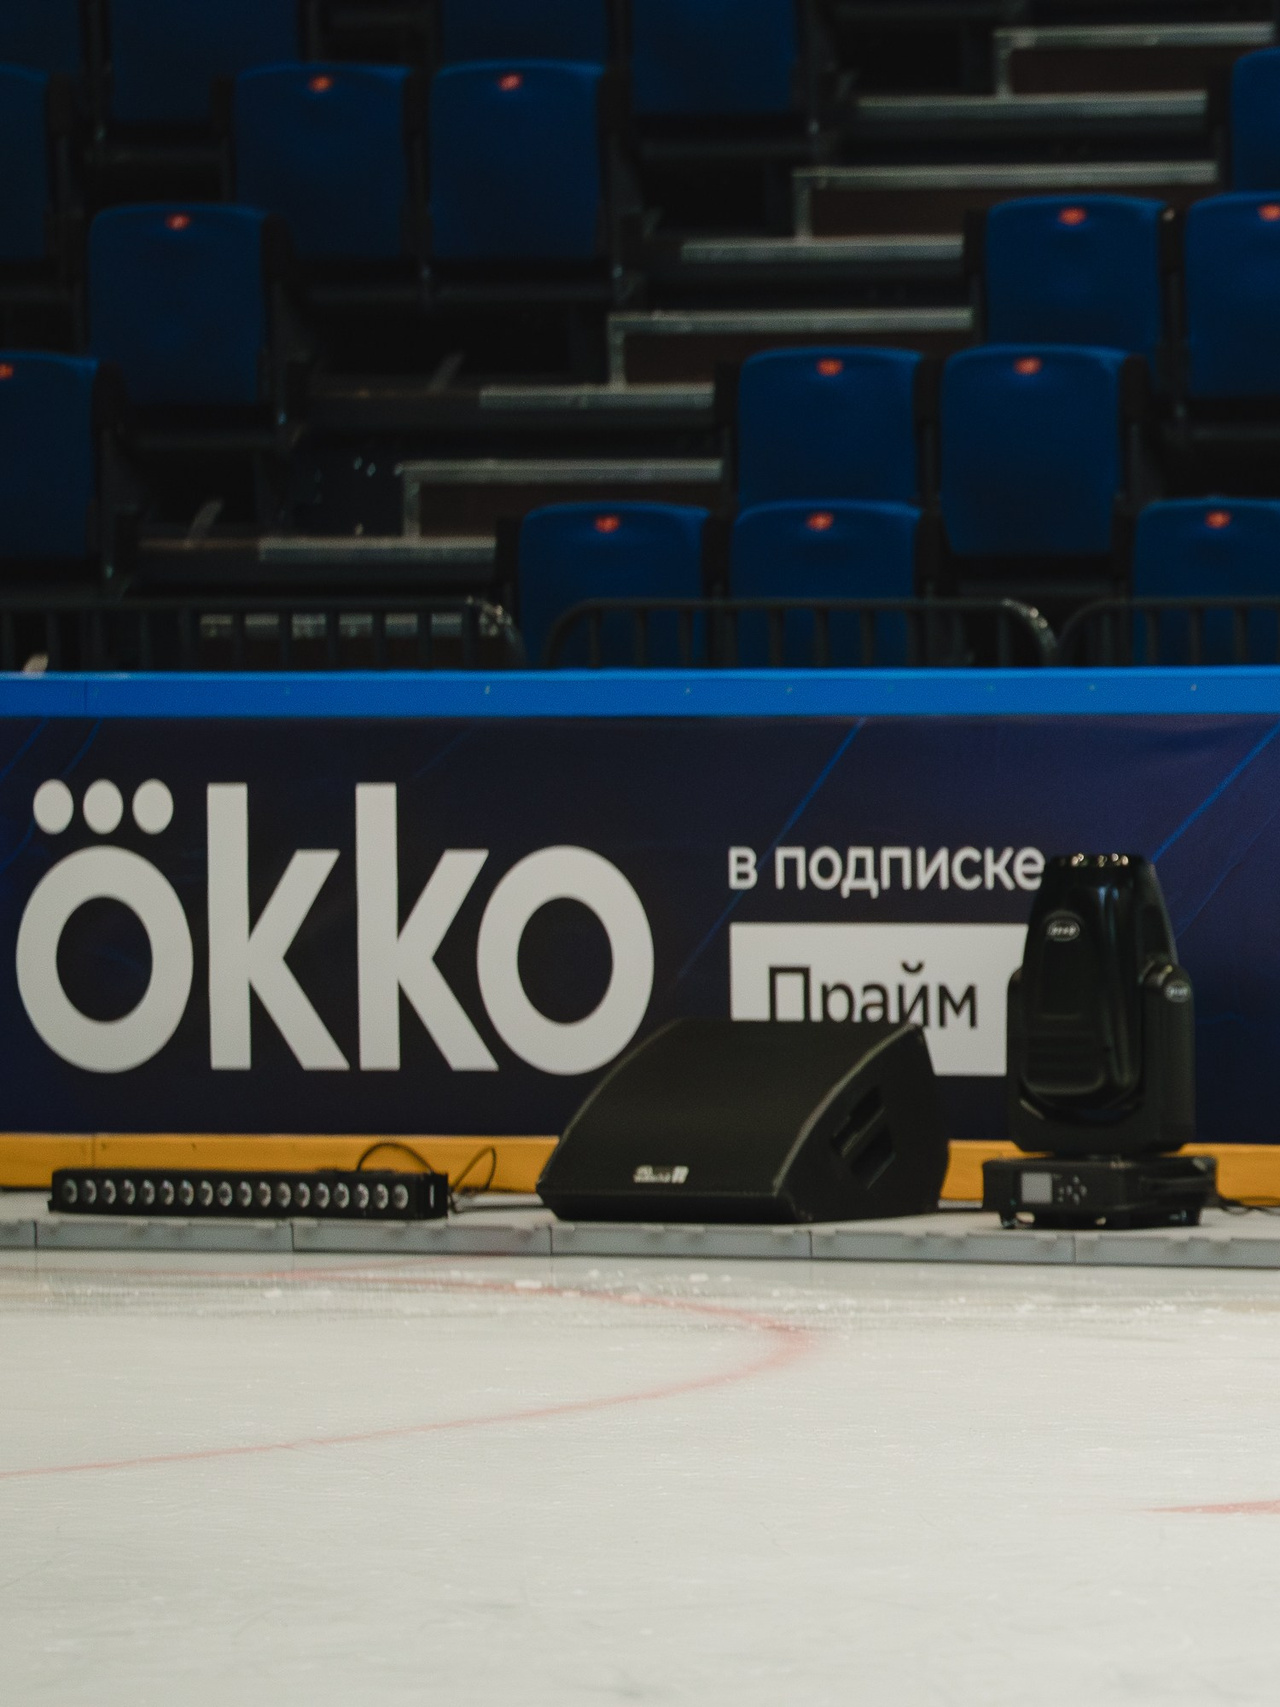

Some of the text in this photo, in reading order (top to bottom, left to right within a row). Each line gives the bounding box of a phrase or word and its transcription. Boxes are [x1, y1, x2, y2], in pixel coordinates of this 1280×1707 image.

[728, 846, 1046, 899] в подписке
[768, 961, 978, 1029] Прайм
